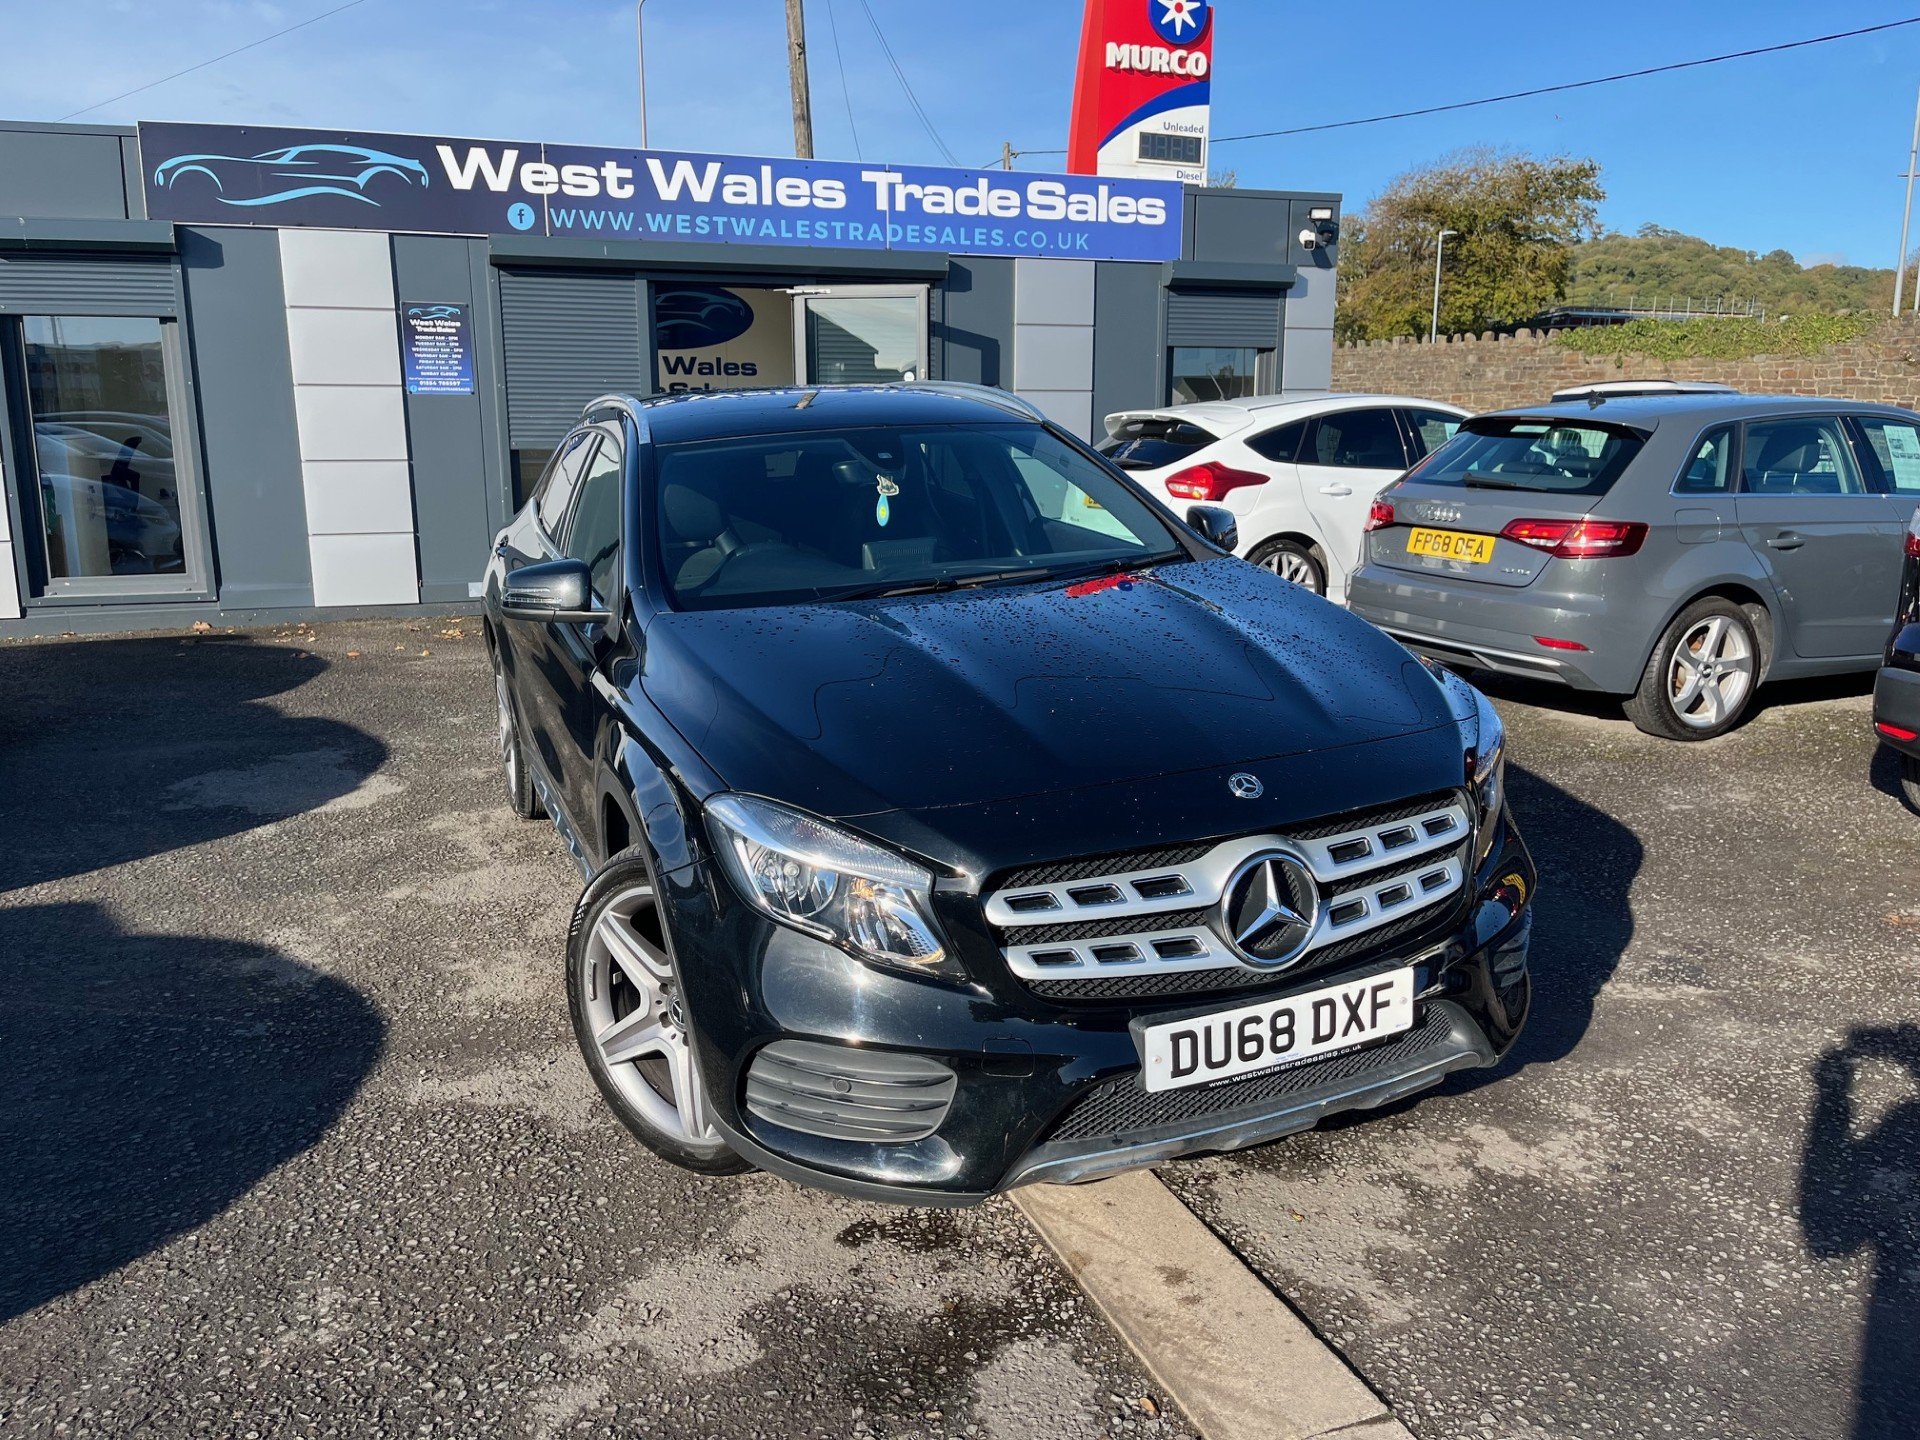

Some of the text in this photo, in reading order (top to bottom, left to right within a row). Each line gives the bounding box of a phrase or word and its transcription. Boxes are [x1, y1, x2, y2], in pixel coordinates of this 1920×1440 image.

[1105, 41, 1208, 77] MURCO
[1163, 122, 1204, 134] Unleaded
[435, 144, 1167, 226] West Wales Trade Sales
[1176, 170, 1202, 181] Diesel
[550, 207, 1089, 250] WWW.WESTWALESTRADESALES.CO.UK
[662, 355, 758, 377] Wales
[1413, 531, 1484, 558] FP68 OEA
[1170, 980, 1394, 1079] DU68 DXF
